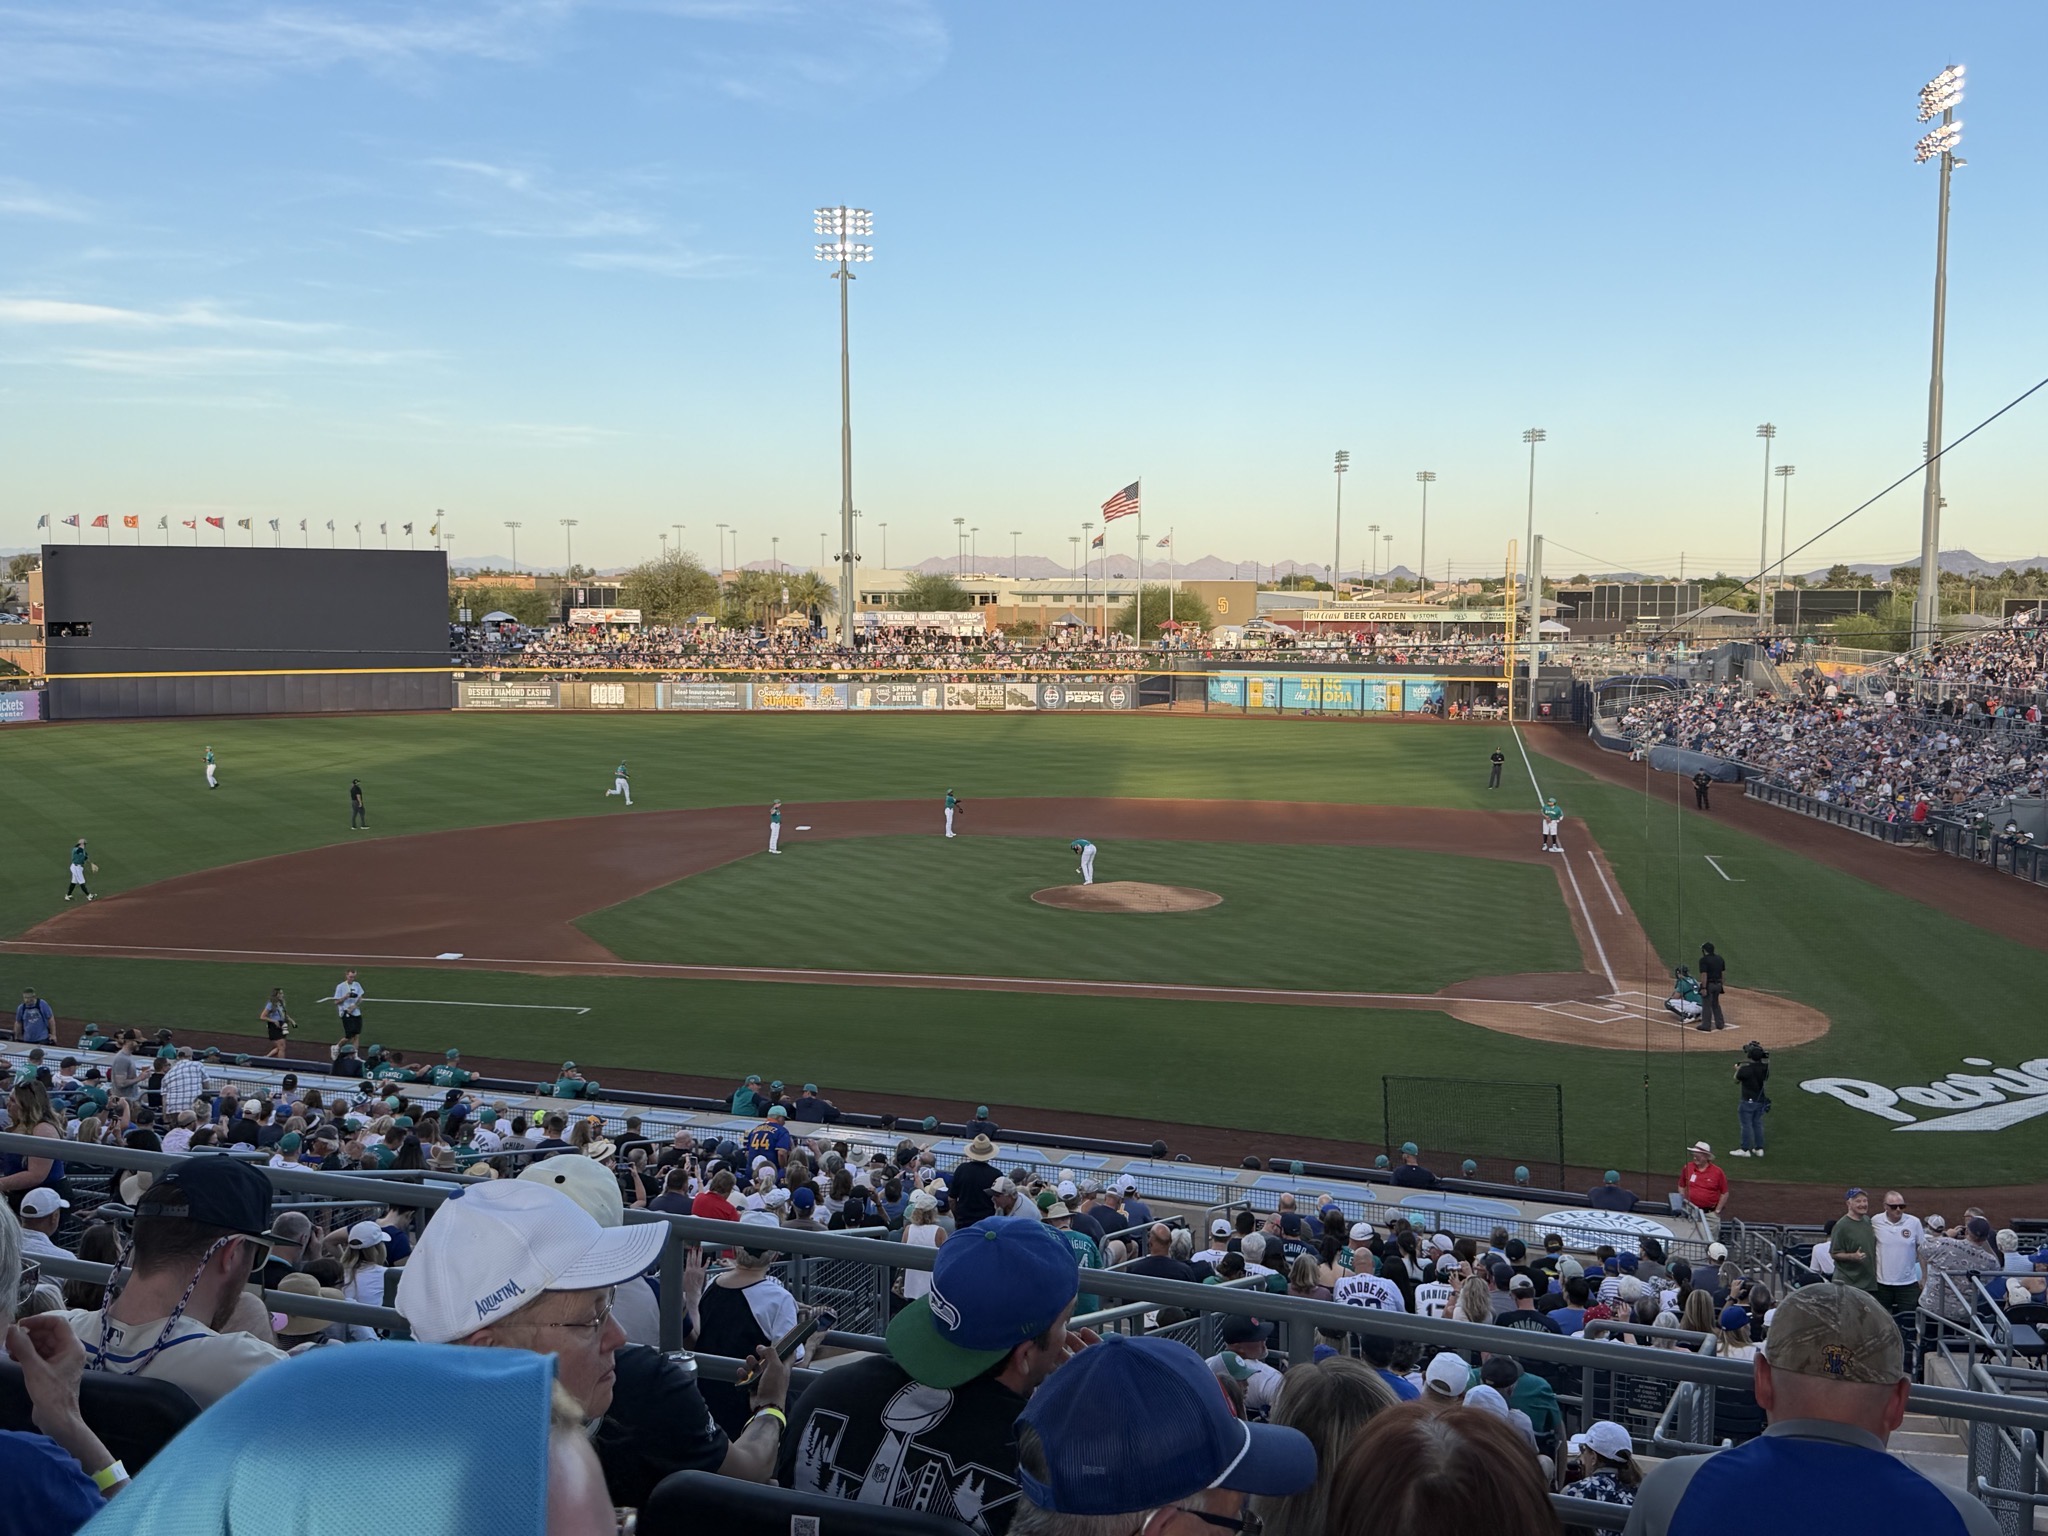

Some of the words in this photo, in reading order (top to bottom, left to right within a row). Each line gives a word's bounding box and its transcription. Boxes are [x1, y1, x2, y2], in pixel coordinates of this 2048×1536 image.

[1304, 611, 1320, 620] West
[1321, 611, 1341, 620] Coast
[1343, 612, 1367, 620] BEER
[1369, 612, 1406, 620] GARDEN
[1301, 678, 1342, 690] BRNG
[468, 688, 492, 697] DESERT
[494, 688, 525, 697] DIAMOND
[526, 688, 551, 697] CASINO
[716, 689, 736, 697] Agency
[758, 686, 784, 699] Swing
[1294, 691, 1306, 700] the
[763, 695, 805, 707] SUMMER
[1065, 695, 1104, 703] PEPSI
[502, 1141, 526, 1151] ICHIRO
[751, 1133, 770, 1150] 44
[1550, 1211, 1662, 1233] PEORIA
[1282, 1242, 1308, 1254] CHIRO
[1338, 1281, 1389, 1302] SANDBERG
[1420, 1289, 1453, 1302] HANIG
[474, 1278, 526, 1321] AQUAFINA
[1641, 1389, 1662, 1397] OBJECTS
